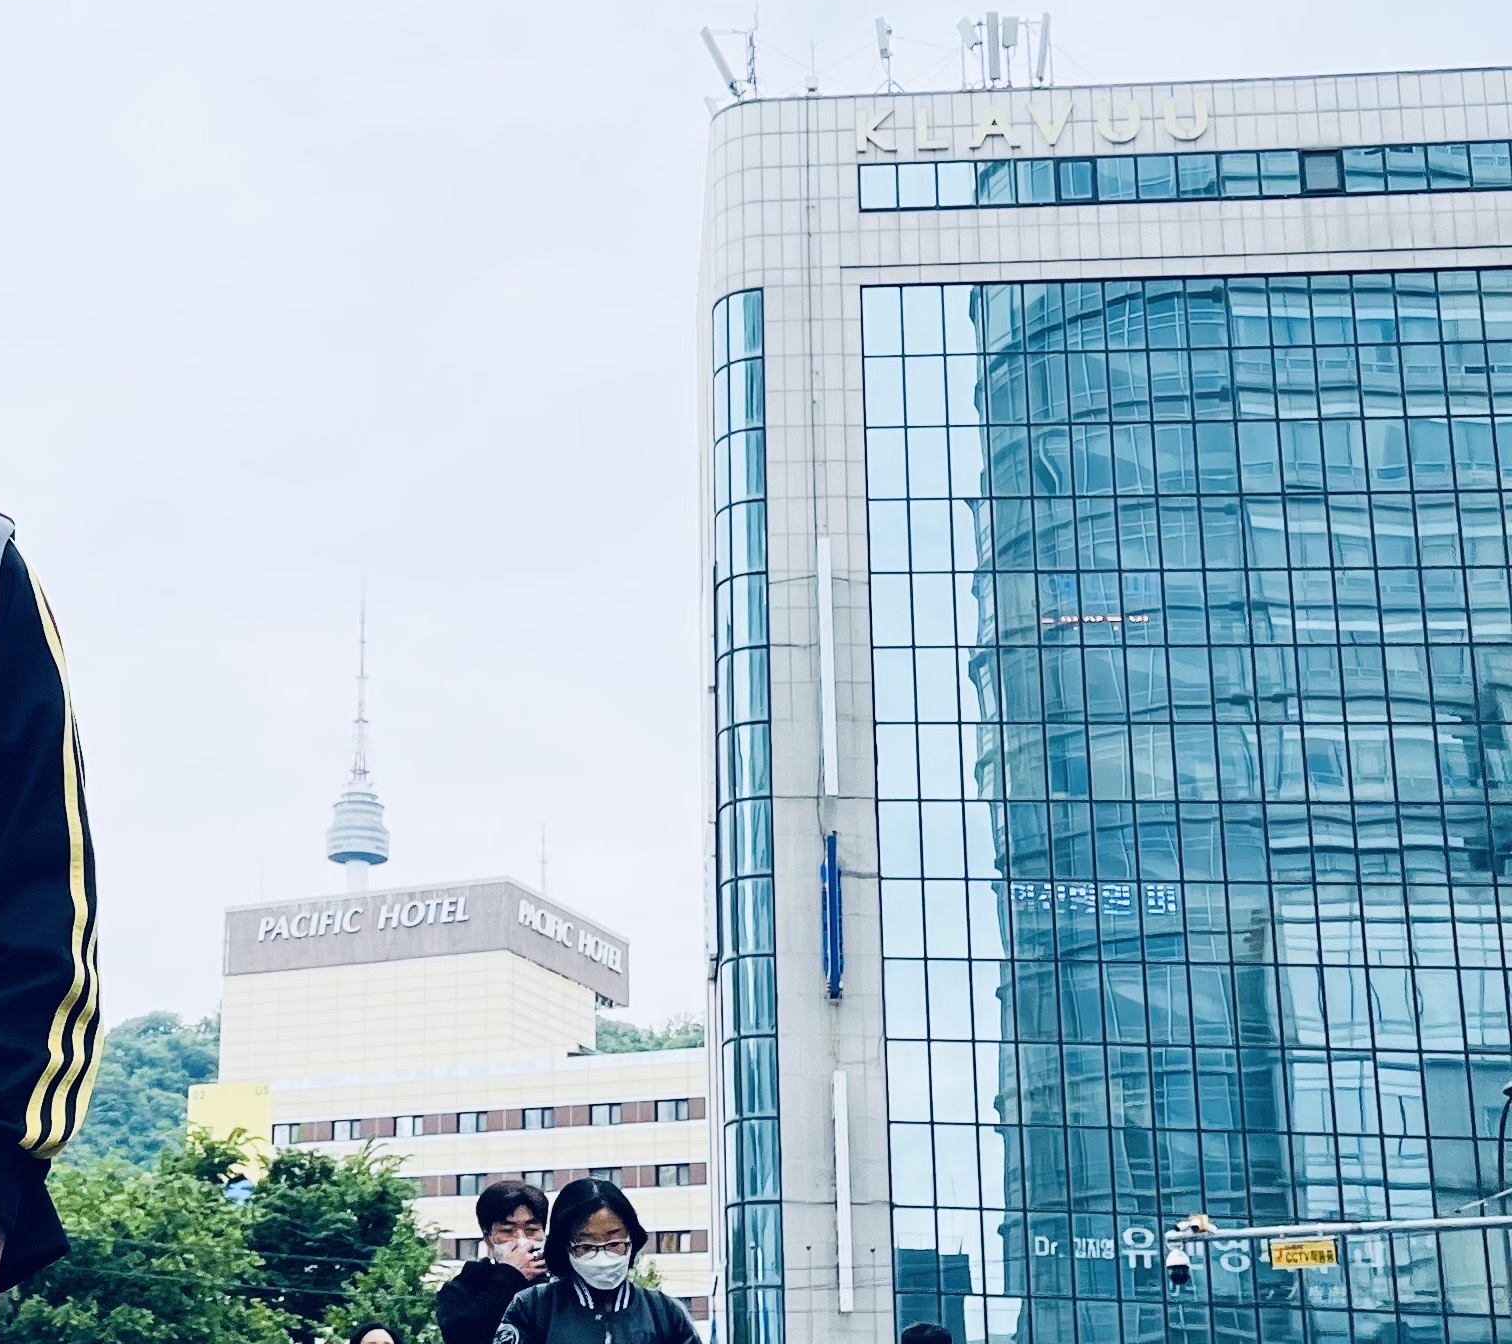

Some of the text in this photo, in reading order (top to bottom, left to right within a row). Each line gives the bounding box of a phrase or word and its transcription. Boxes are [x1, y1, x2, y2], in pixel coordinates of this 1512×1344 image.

[854, 96, 1208, 154] KLAVUU
[256, 896, 471, 943] PACIFIC HOTEL
[517, 898, 625, 974] PACIFIC HOTEL
[1034, 1235, 1065, 1258] Dr.
